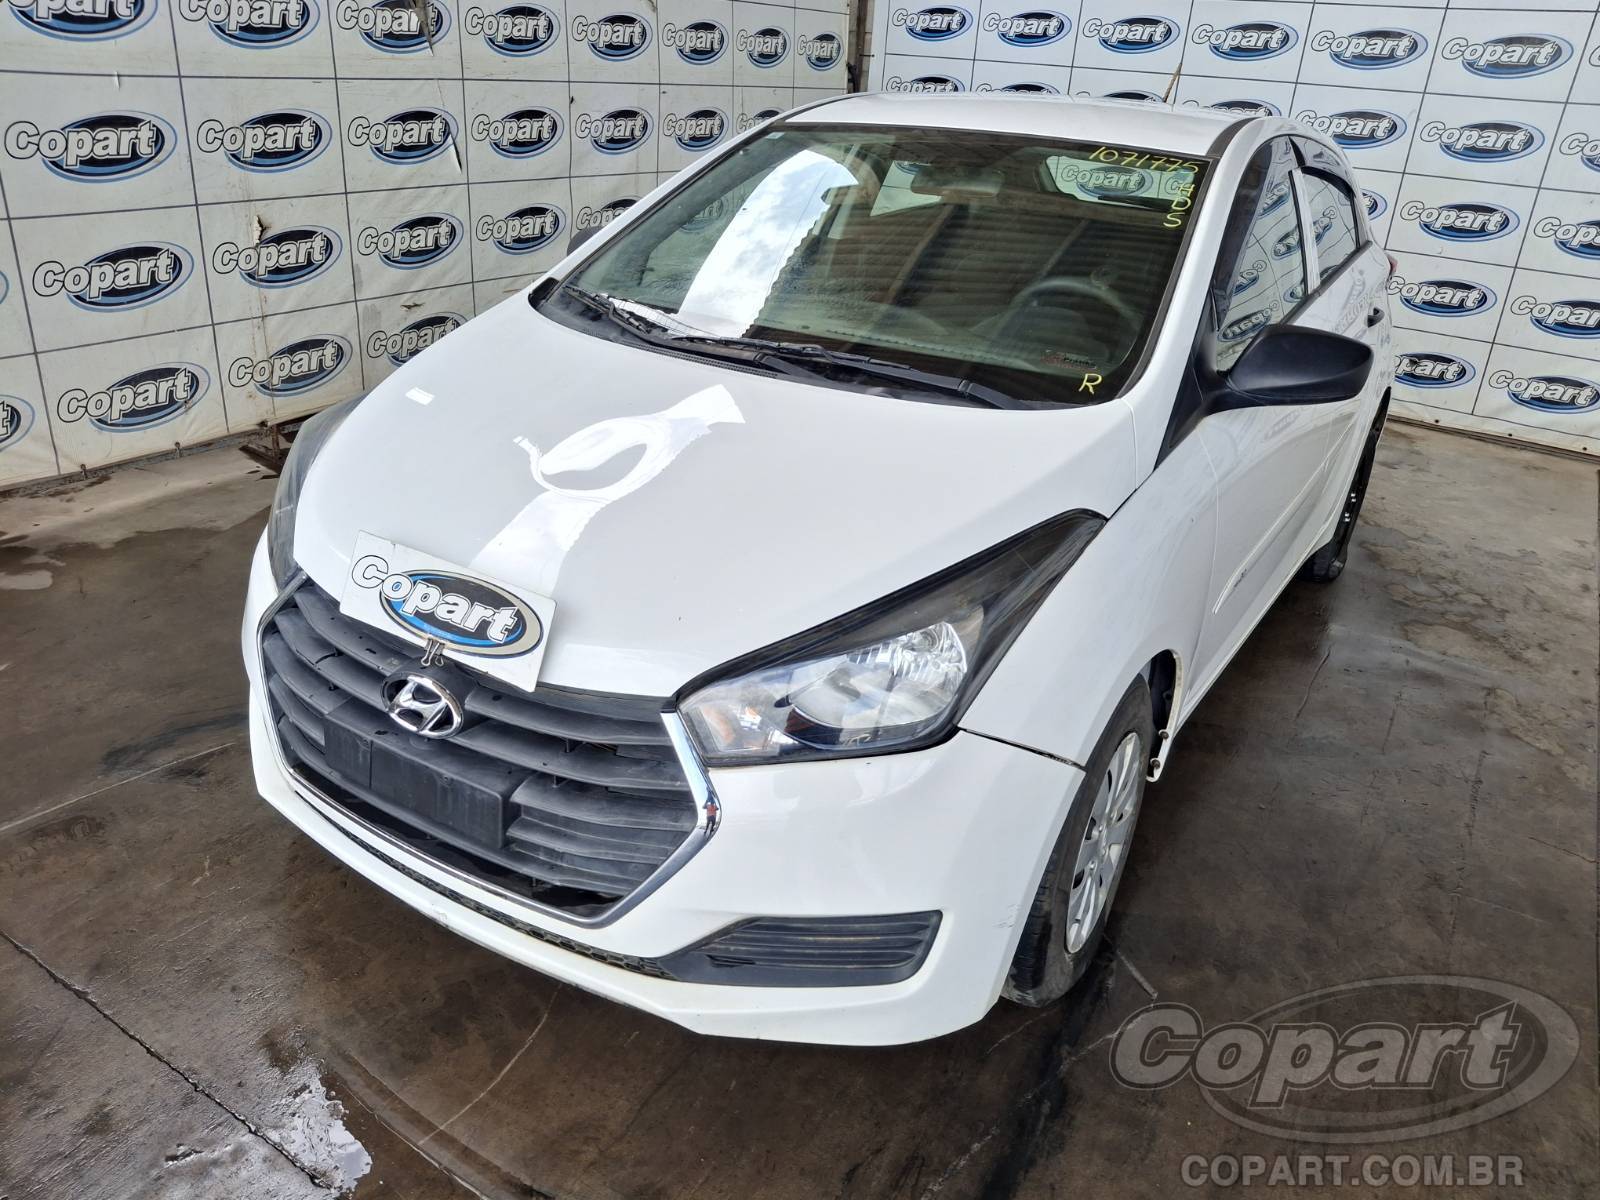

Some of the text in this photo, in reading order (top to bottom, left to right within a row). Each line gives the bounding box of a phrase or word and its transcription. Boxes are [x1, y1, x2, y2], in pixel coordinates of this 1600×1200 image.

[180, 0, 303, 33] Copart
[465, 7, 549, 44] Copart
[893, 8, 963, 31] Copart
[984, 13, 1060, 37] Copart
[1083, 18, 1169, 44] Copart
[572, 15, 646, 52] Copart
[663, 23, 722, 54] Copart
[737, 30, 787, 56] Copart
[798, 34, 839, 58] Copart
[1193, 25, 1286, 51] Copart
[1312, 30, 1418, 59] Copart
[1442, 37, 1557, 68] Copart
[197, 118, 316, 160] Copart
[347, 114, 445, 153] Copart
[472, 113, 554, 147] Copart
[575, 112, 646, 144] Copart
[662, 113, 722, 140] Copart
[1421, 121, 1532, 152] Copart
[4, 120, 156, 168] Copart
[1089, 146, 1199, 173] 1071775
[1061, 164, 1143, 190] Copart
[476, 210, 556, 245] Copart
[1400, 200, 1505, 232] Copart
[212, 231, 326, 277] Copart
[357, 219, 452, 259] Copart
[32, 250, 174, 299] Copart
[1387, 276, 1482, 308] Copart
[227, 338, 339, 387] Copart
[57, 367, 191, 423] Copart
[1079, 373, 1102, 394] R
[1489, 369, 1597, 406] Copart
[351, 555, 518, 644] Copart
